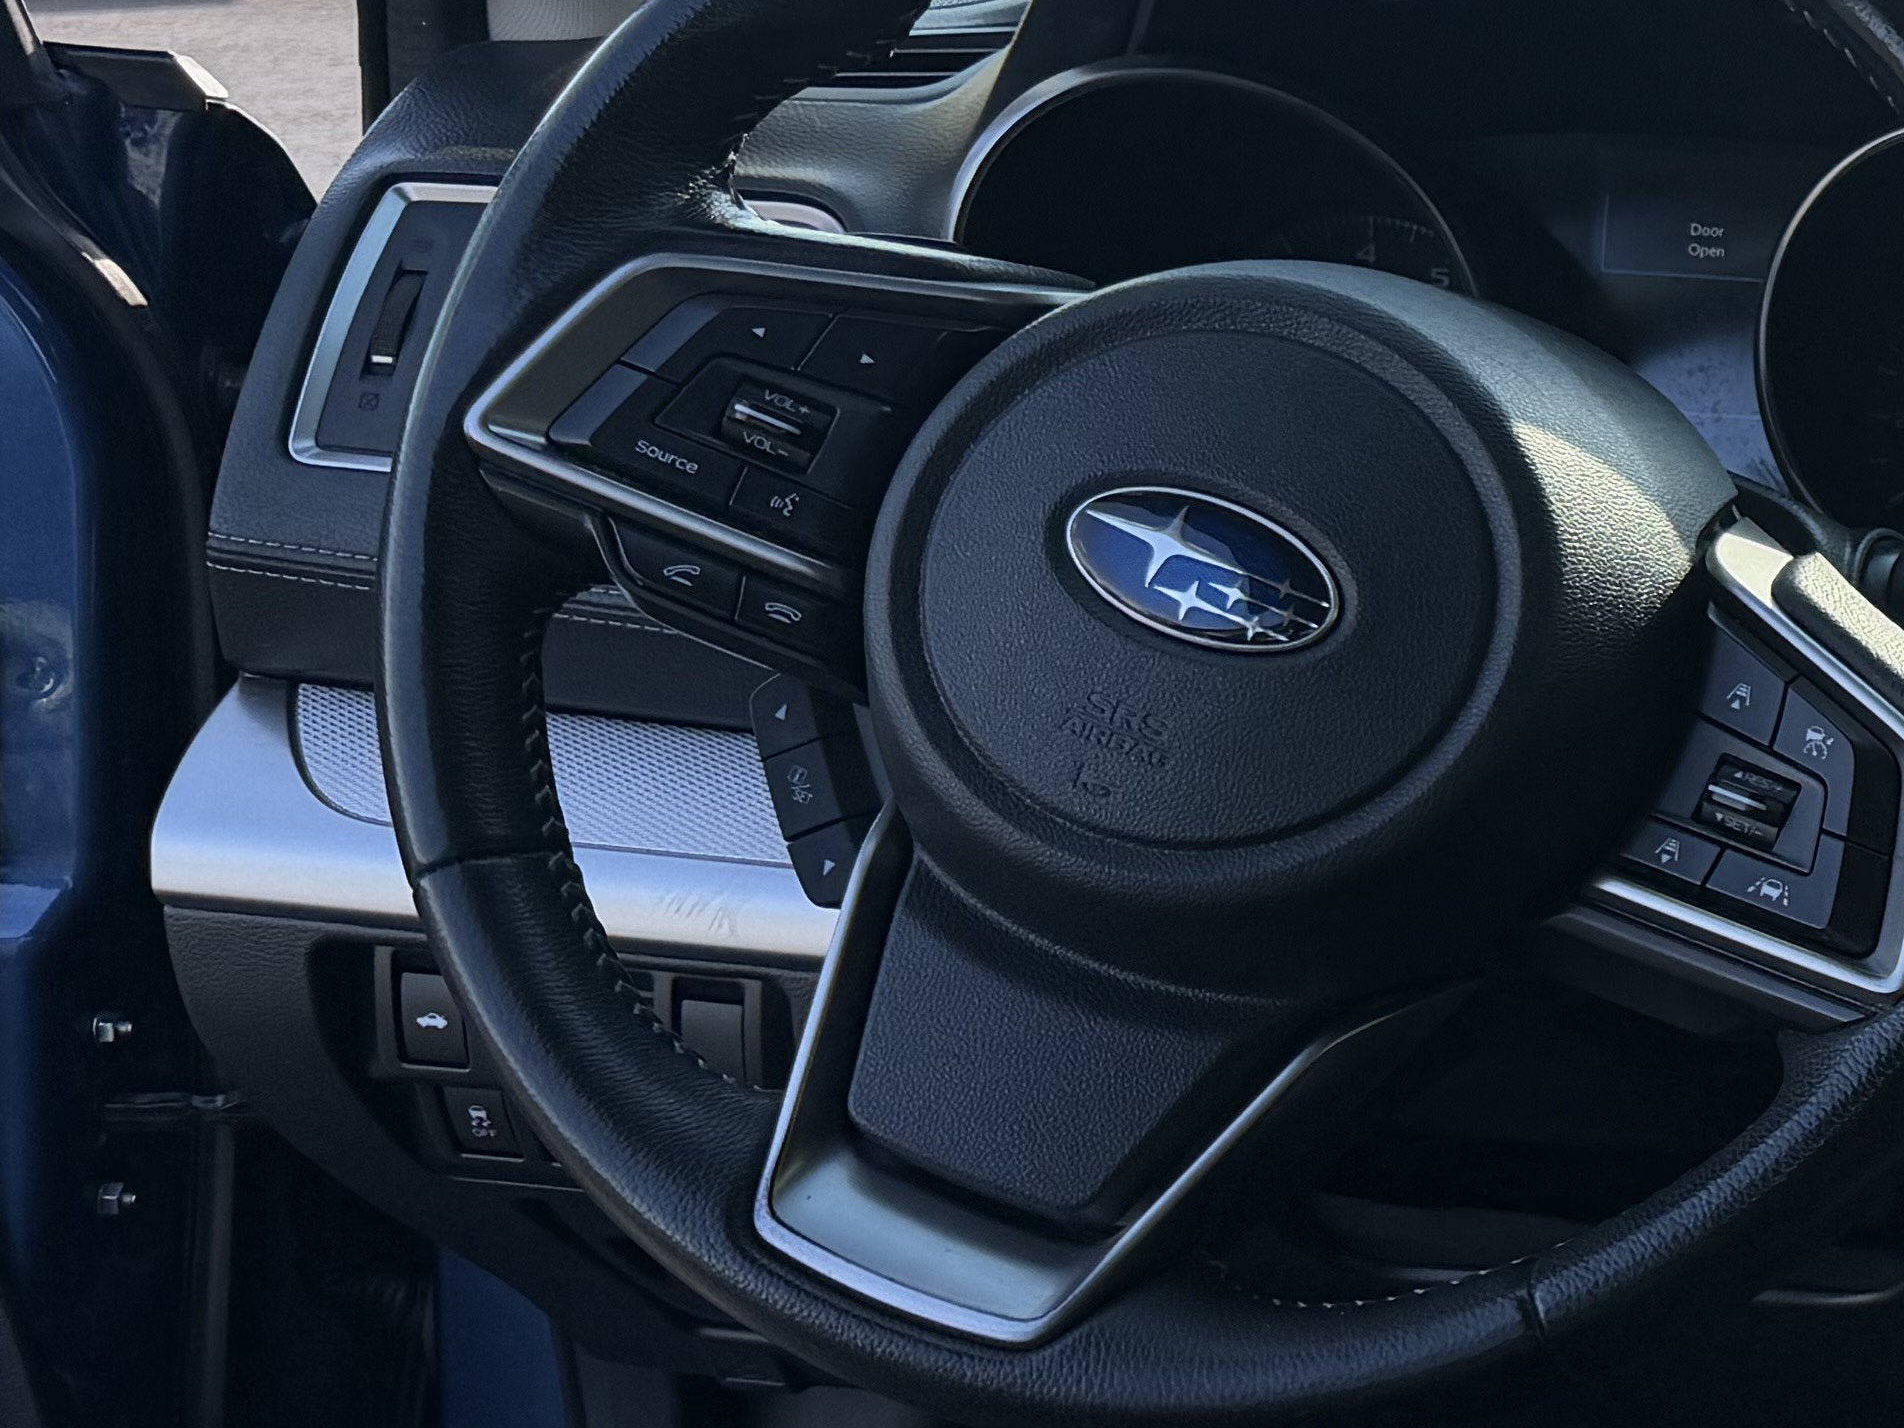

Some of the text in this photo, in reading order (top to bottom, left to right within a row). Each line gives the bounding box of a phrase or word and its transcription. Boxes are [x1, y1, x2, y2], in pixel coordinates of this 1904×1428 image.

[1690, 223, 1724, 237] Door
[1688, 243, 1725, 258] Open
[635, 439, 699, 474] Source
